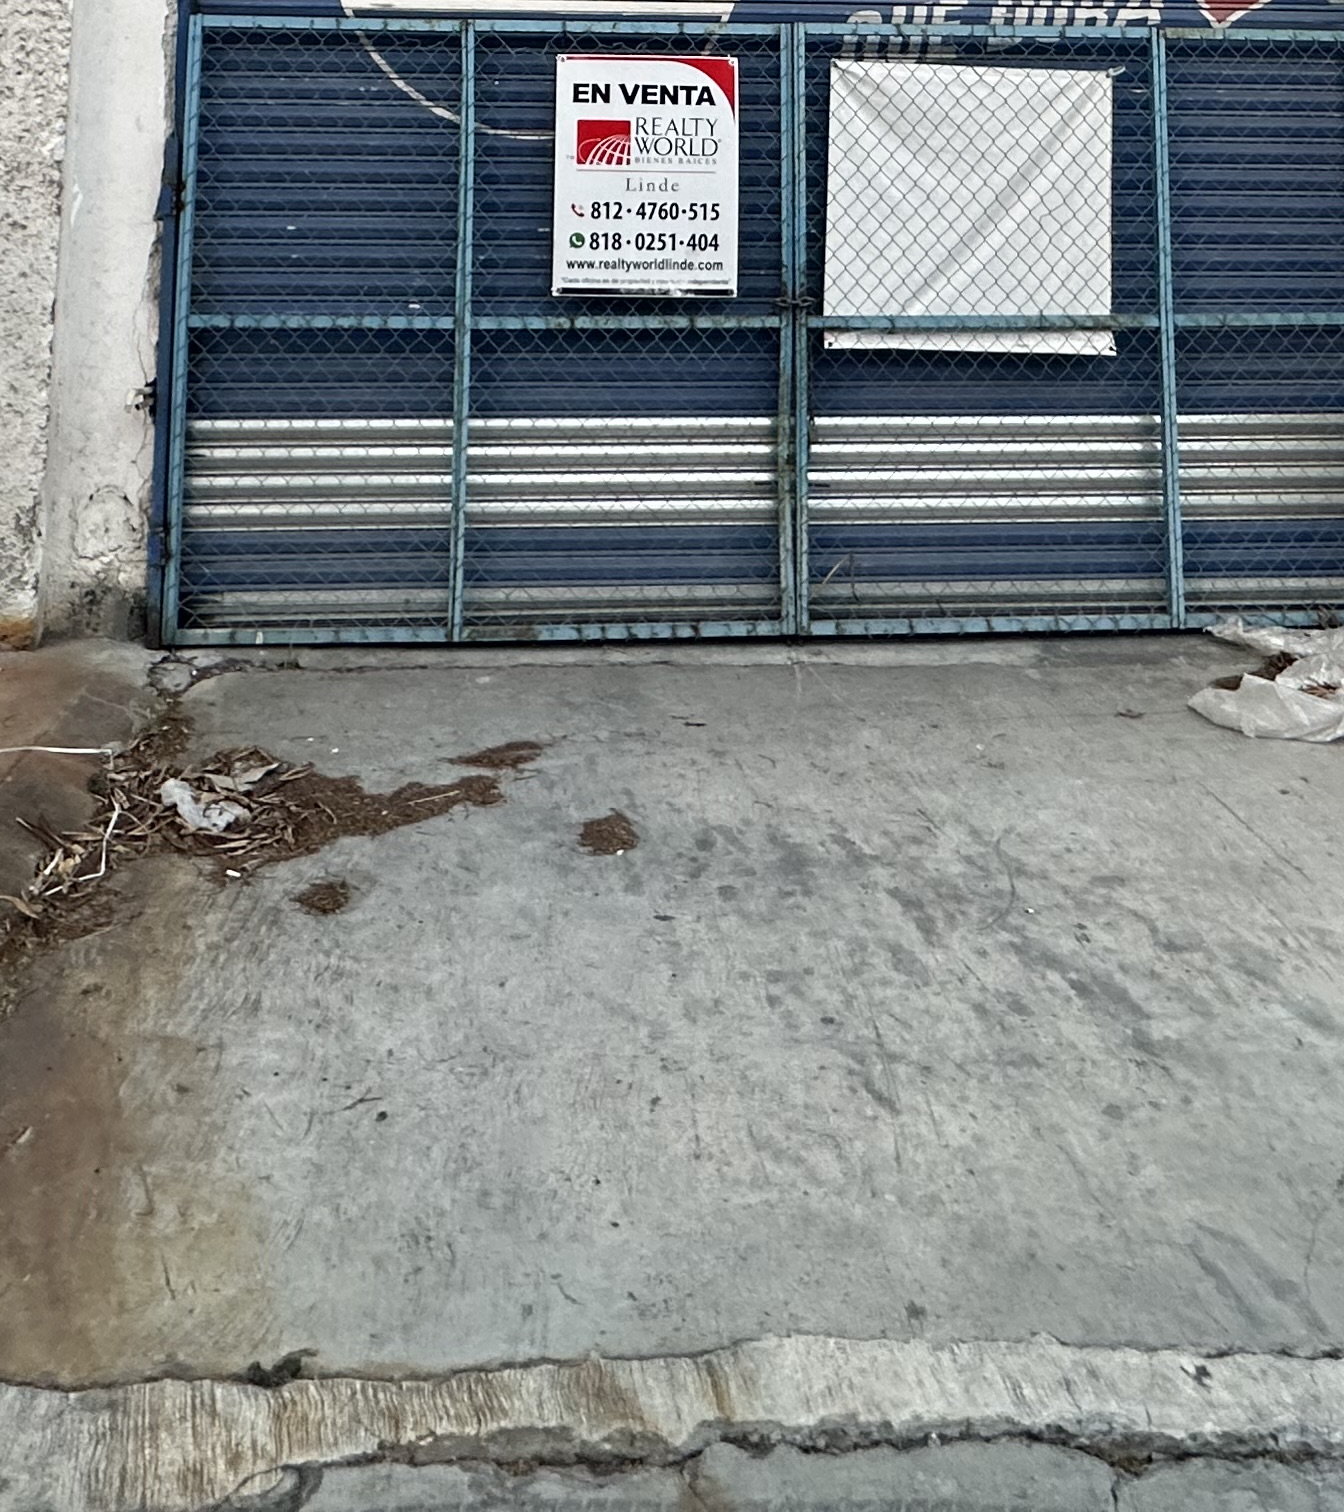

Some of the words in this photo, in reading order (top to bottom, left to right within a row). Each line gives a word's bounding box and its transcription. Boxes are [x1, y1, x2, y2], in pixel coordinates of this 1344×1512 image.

[571, 82, 611, 104] EN
[618, 83, 717, 106] VENTA
[635, 116, 718, 137] REALTY
[634, 136, 719, 157] WORLD
[625, 176, 681, 193] Linde
[565, 257, 724, 274] www.realtyworldlinde.com
